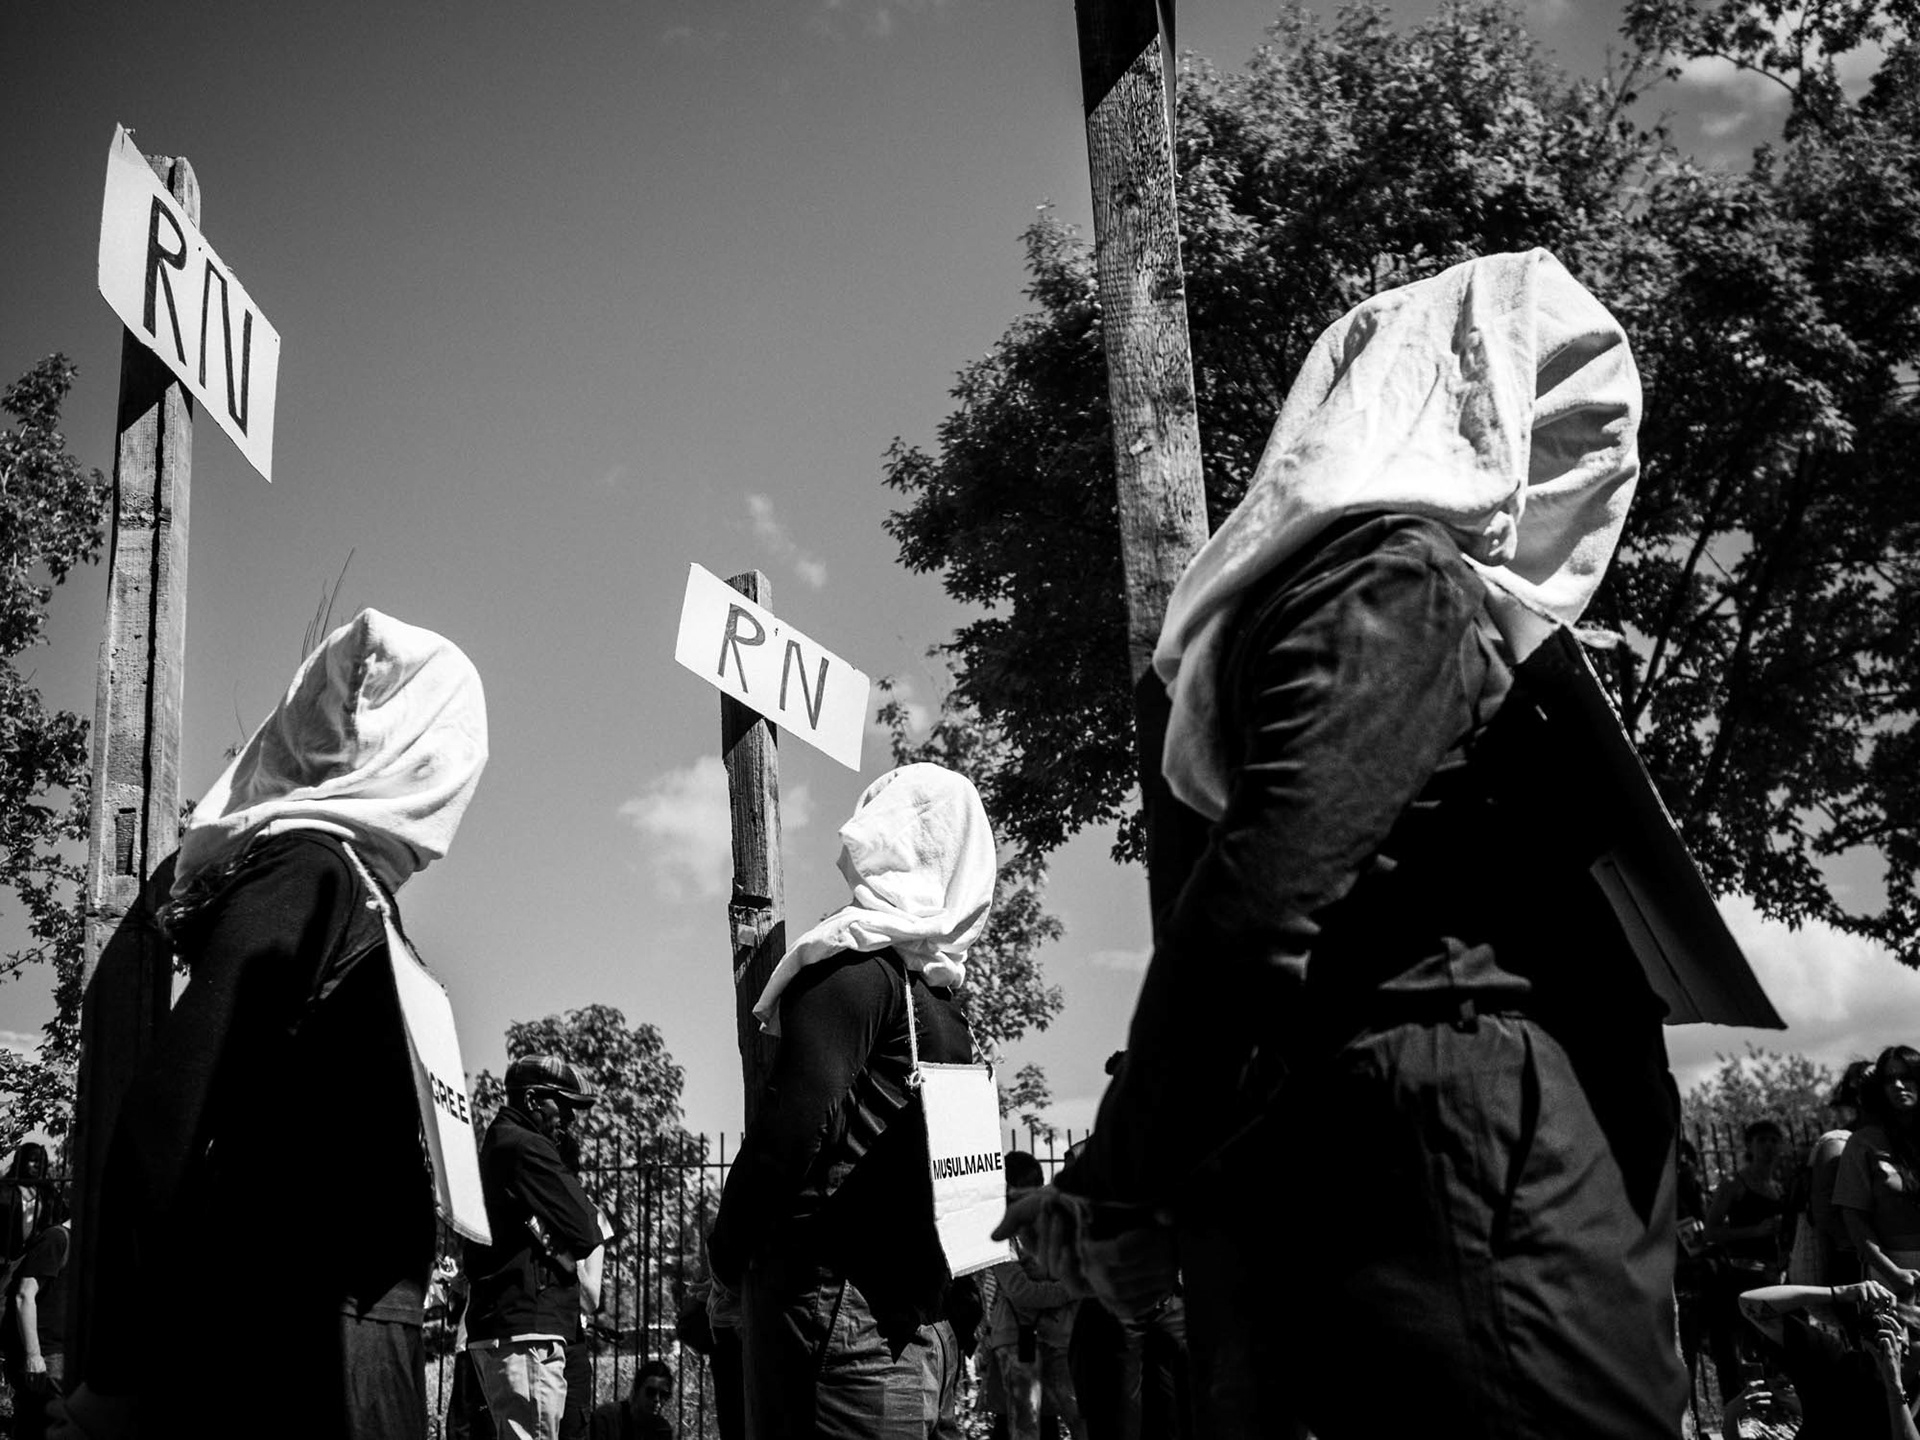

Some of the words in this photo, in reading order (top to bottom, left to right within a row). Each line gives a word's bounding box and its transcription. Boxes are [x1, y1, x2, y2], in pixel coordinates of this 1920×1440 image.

[143, 195, 252, 438] RN
[718, 603, 829, 730] RN
[933, 1152, 1002, 1180] MUSULMANE
